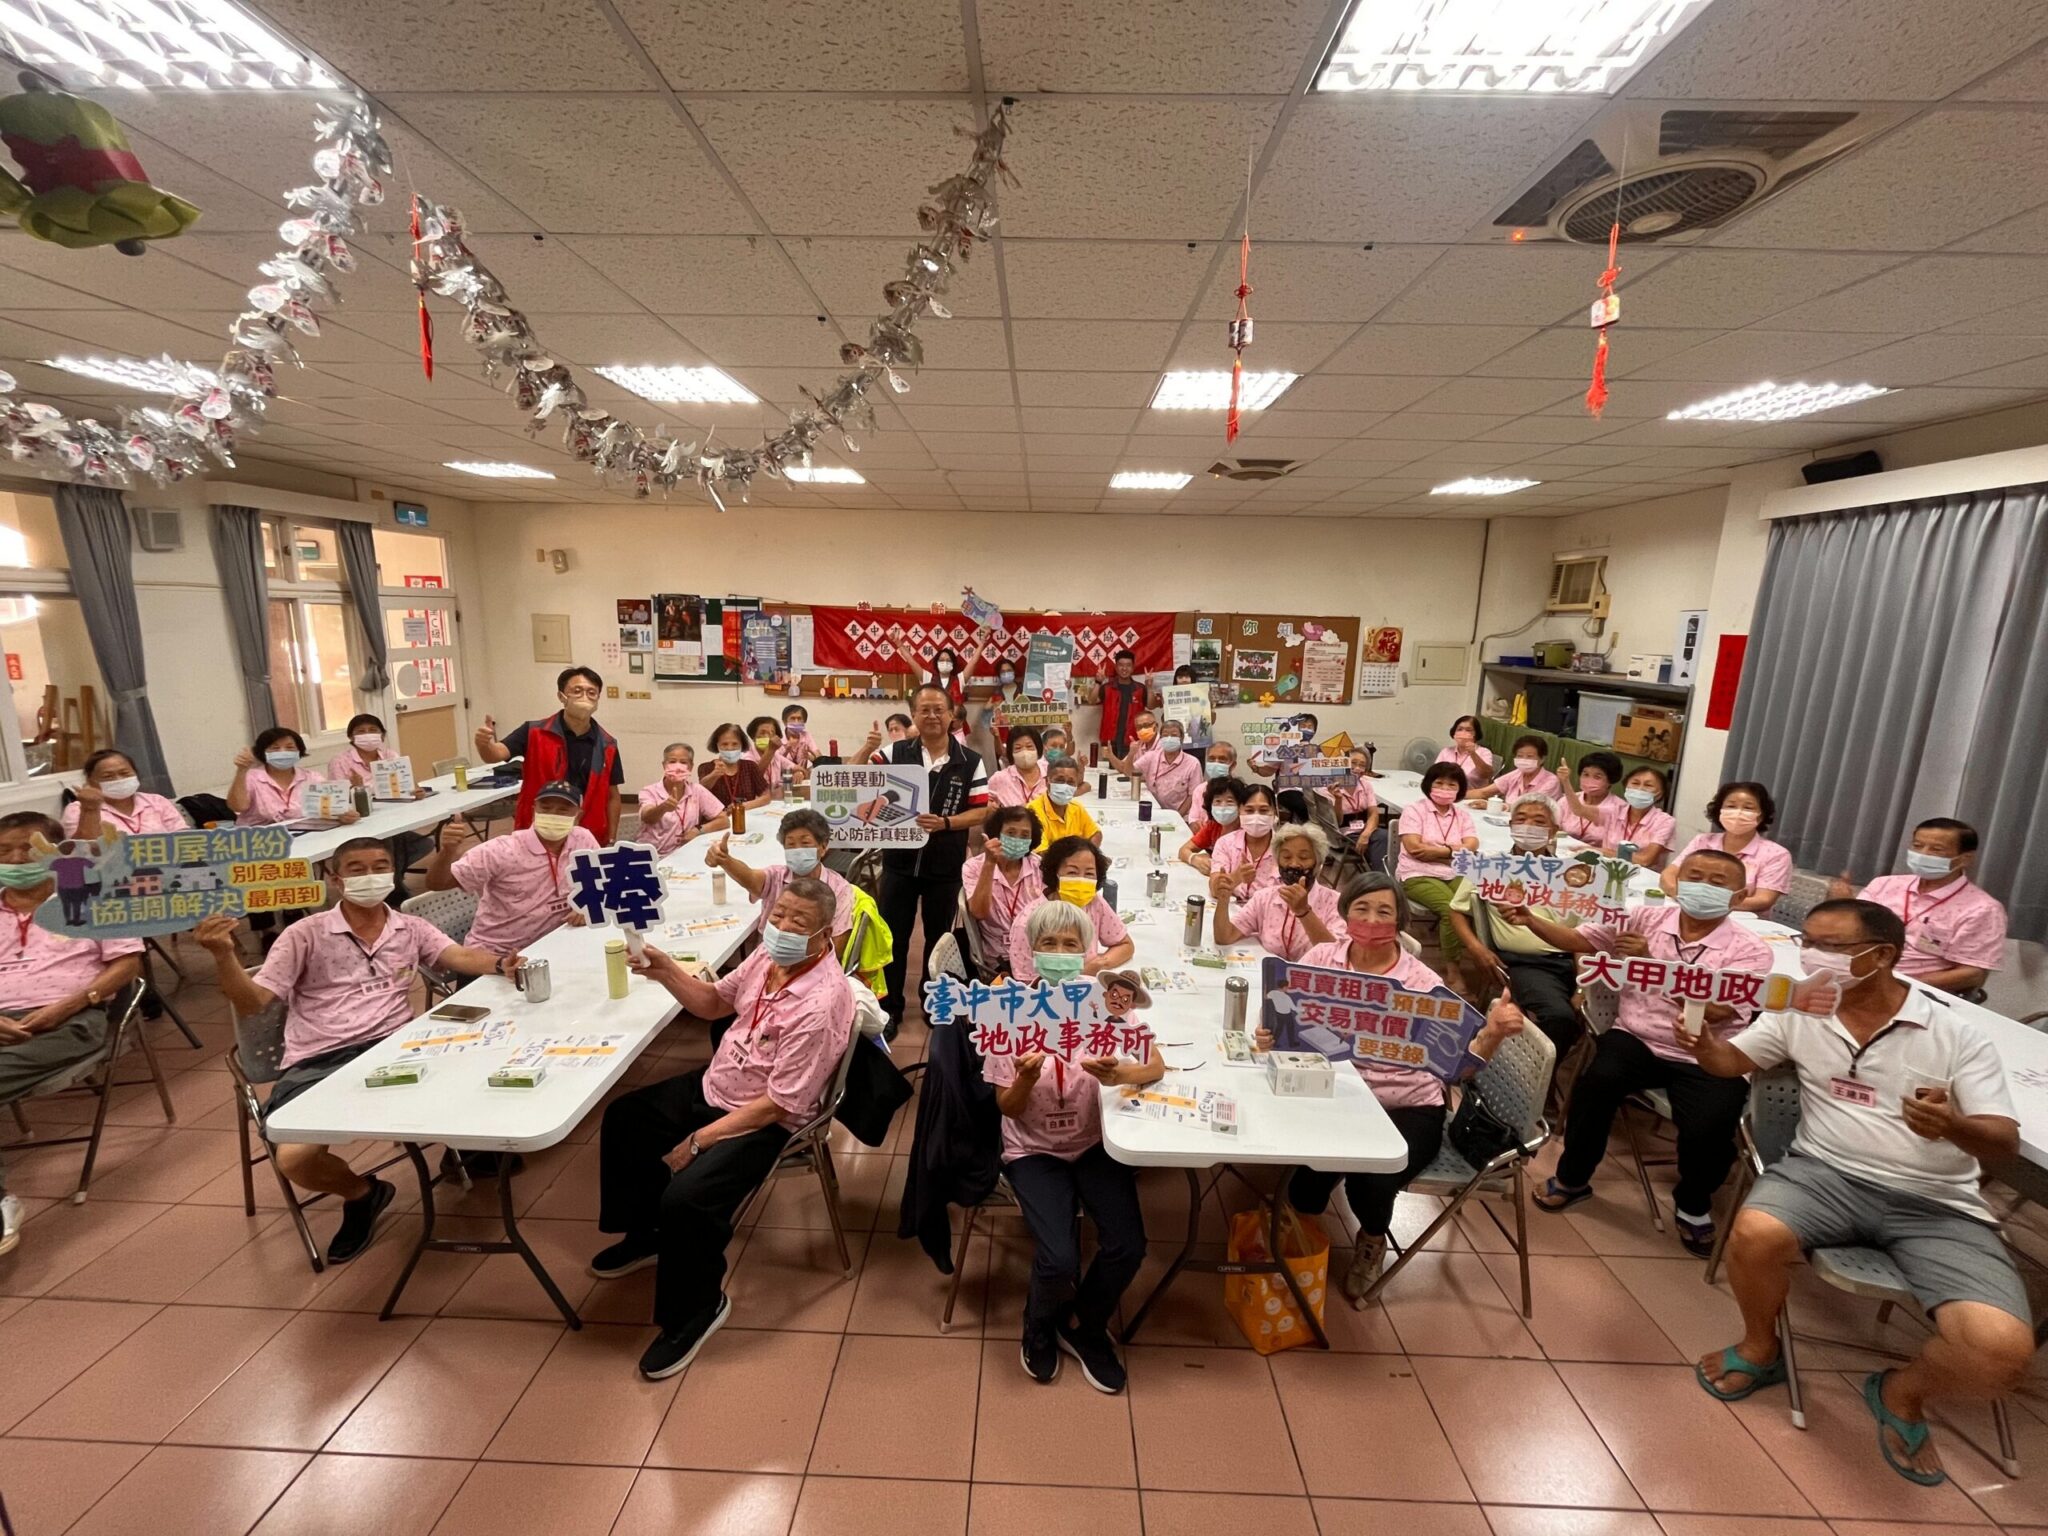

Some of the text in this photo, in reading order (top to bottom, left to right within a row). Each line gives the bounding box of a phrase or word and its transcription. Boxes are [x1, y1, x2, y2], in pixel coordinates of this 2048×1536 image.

[641, 631, 651, 643] 14
[816, 771, 885, 788] 地籍異動
[129, 830, 288, 867] 租屋糾紛
[232, 861, 308, 884] 別急躁
[1453, 850, 1564, 885] 臺中市大甲
[247, 885, 320, 908] 最周到
[570, 846, 663, 930] 棒
[1477, 877, 1630, 932] 地政事務所
[90, 889, 241, 927] 協調解決
[926, 976, 1092, 1024] 臺中市大甲
[1288, 969, 1389, 1005] 買賣租賃
[1580, 956, 1764, 1008] 大甲地政
[1300, 1002, 1409, 1039] 交易實價
[1392, 993, 1462, 1021] 預售屋
[973, 1017, 1155, 1065] 地政事務所
[1358, 1037, 1425, 1064] 要登錄
